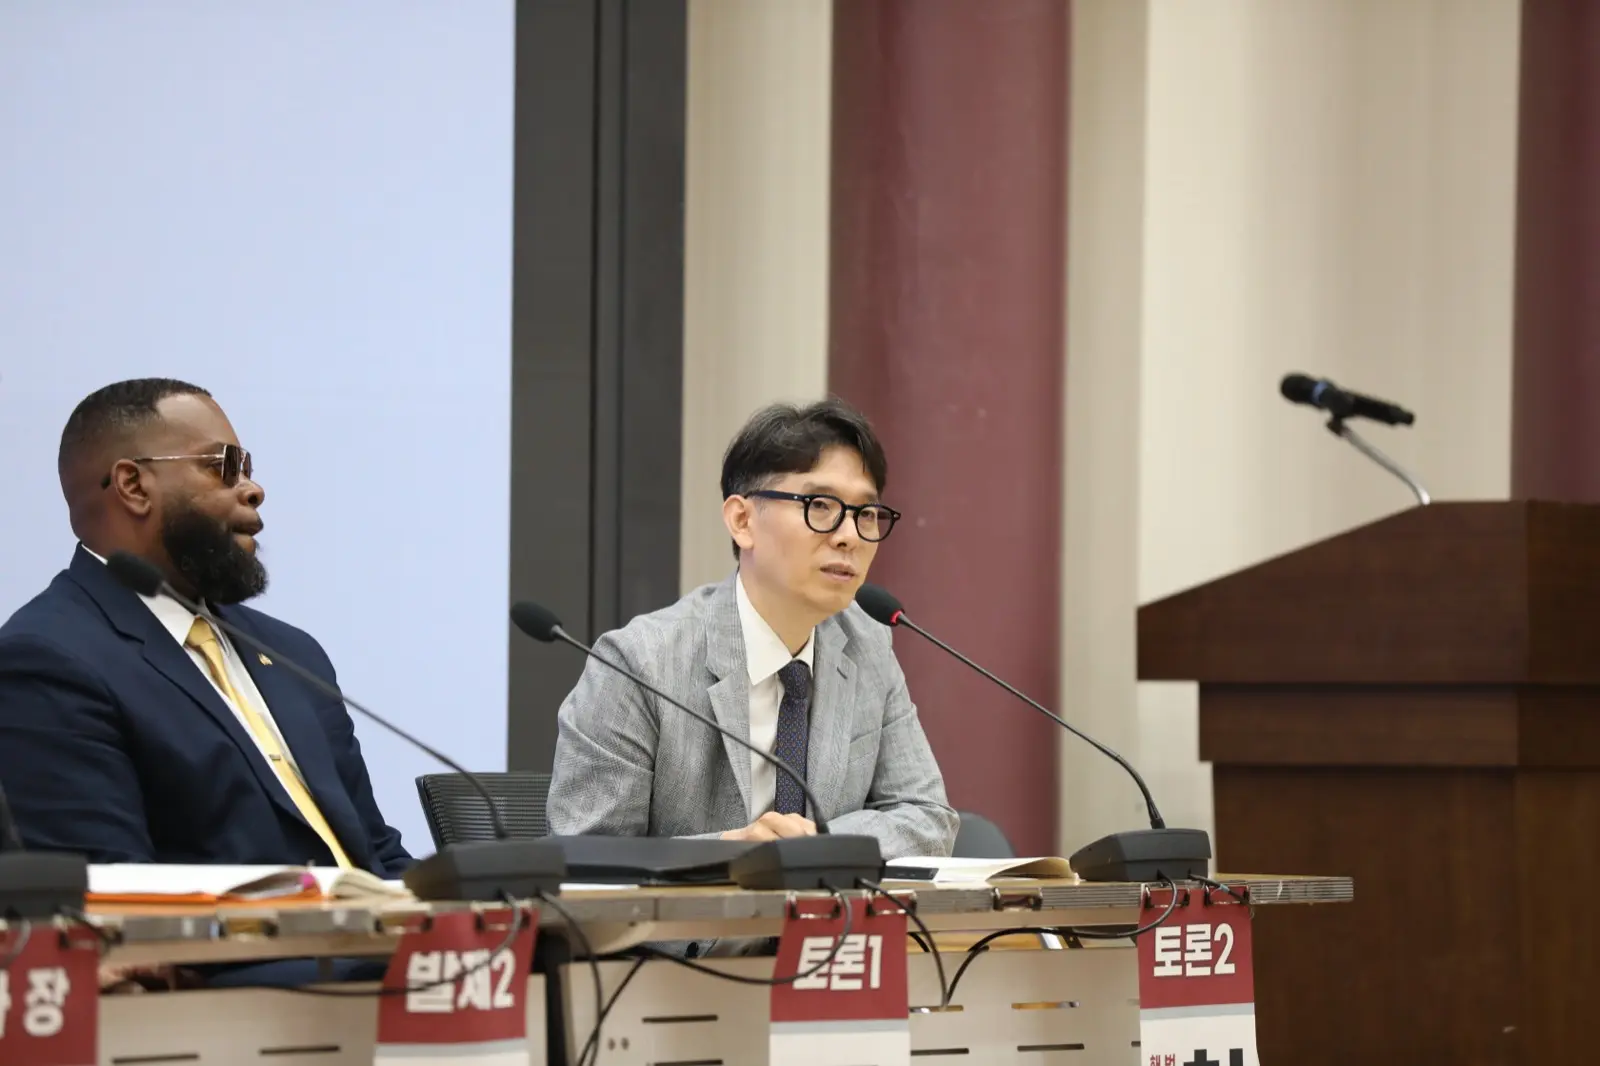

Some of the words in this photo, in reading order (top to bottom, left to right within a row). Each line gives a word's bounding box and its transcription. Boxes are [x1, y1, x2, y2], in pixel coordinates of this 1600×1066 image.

[792, 933, 883, 990] 토론1
[1153, 923, 1235, 976] 토론2
[0, 968, 70, 1039] 장
[406, 948, 515, 1013] 발제2
